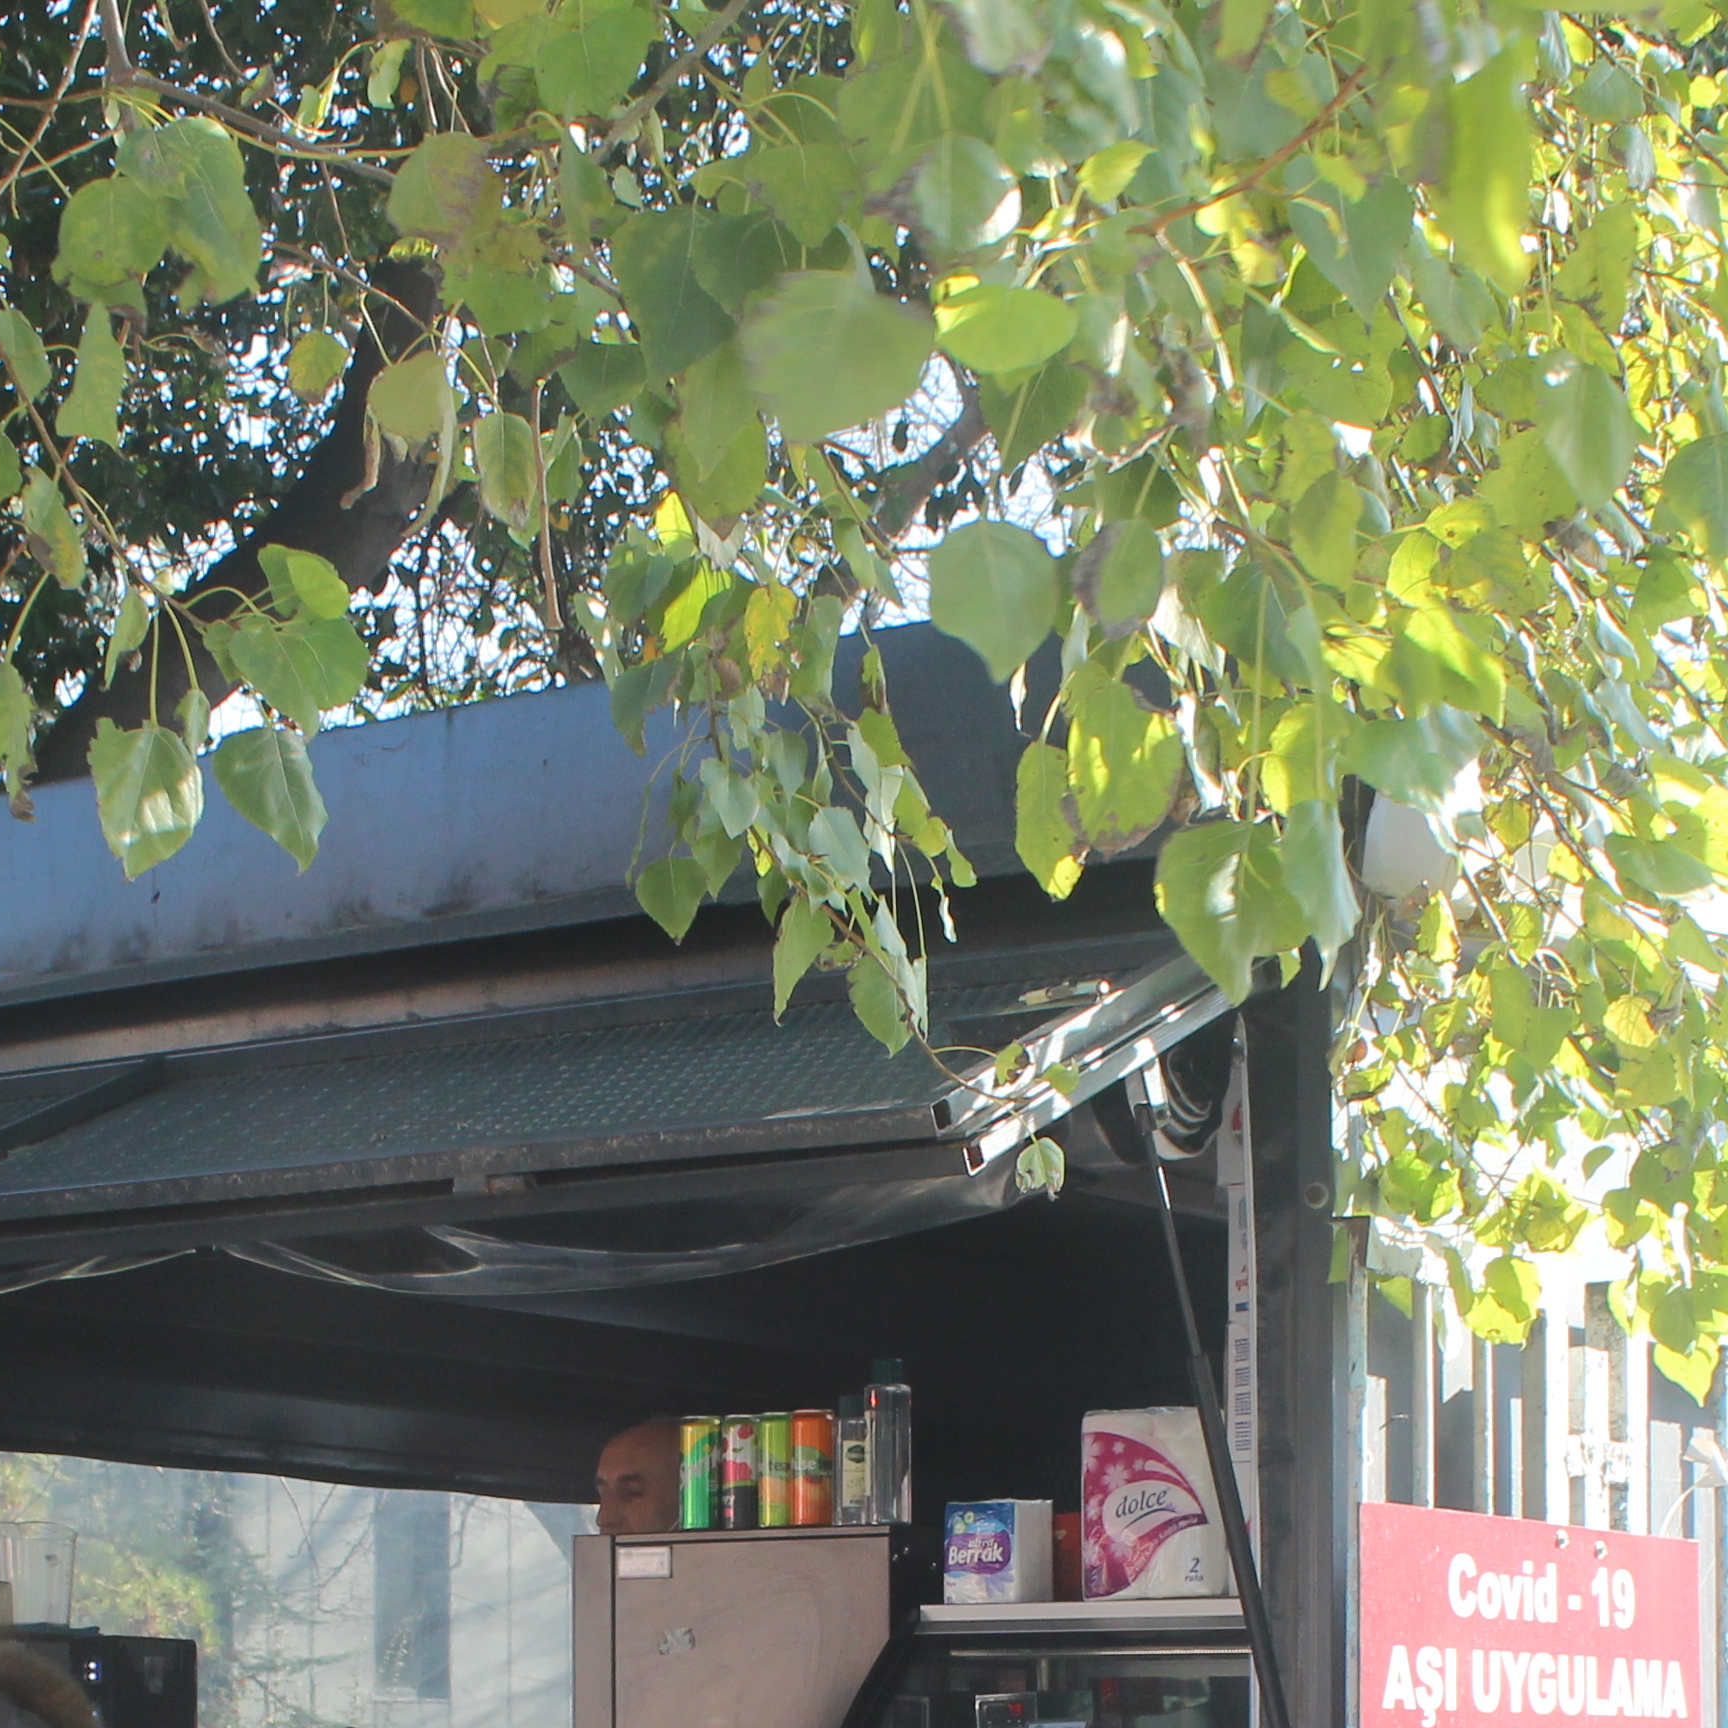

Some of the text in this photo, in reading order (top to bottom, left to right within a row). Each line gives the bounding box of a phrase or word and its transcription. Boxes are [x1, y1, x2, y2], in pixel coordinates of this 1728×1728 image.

[1115, 1488, 1168, 1518] dolce
[948, 1543, 1004, 1566] Berrak
[968, 1538, 995, 1548] ultra
[1189, 1558, 1200, 1574] 2
[1448, 1553, 1558, 1623] Covid
[1591, 1567, 1635, 1629] 19
[1382, 1645, 1688, 1728] AŞI UYGULAMA
